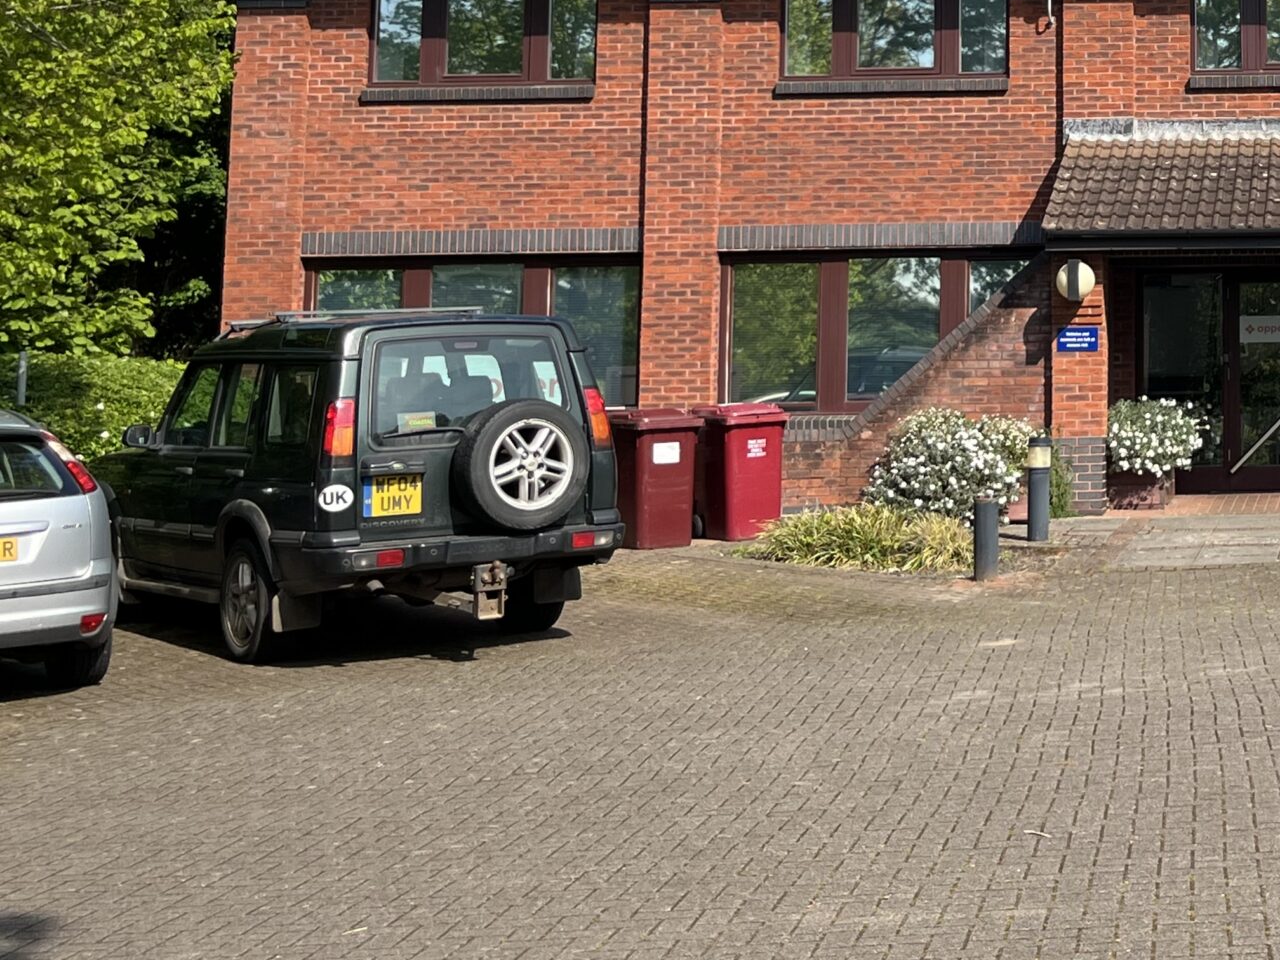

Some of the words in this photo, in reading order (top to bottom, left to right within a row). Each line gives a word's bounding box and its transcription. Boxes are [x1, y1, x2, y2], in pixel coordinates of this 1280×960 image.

[375, 475, 419, 494] WF04
[322, 490, 349, 506] UK
[380, 494, 413, 512] UMY
